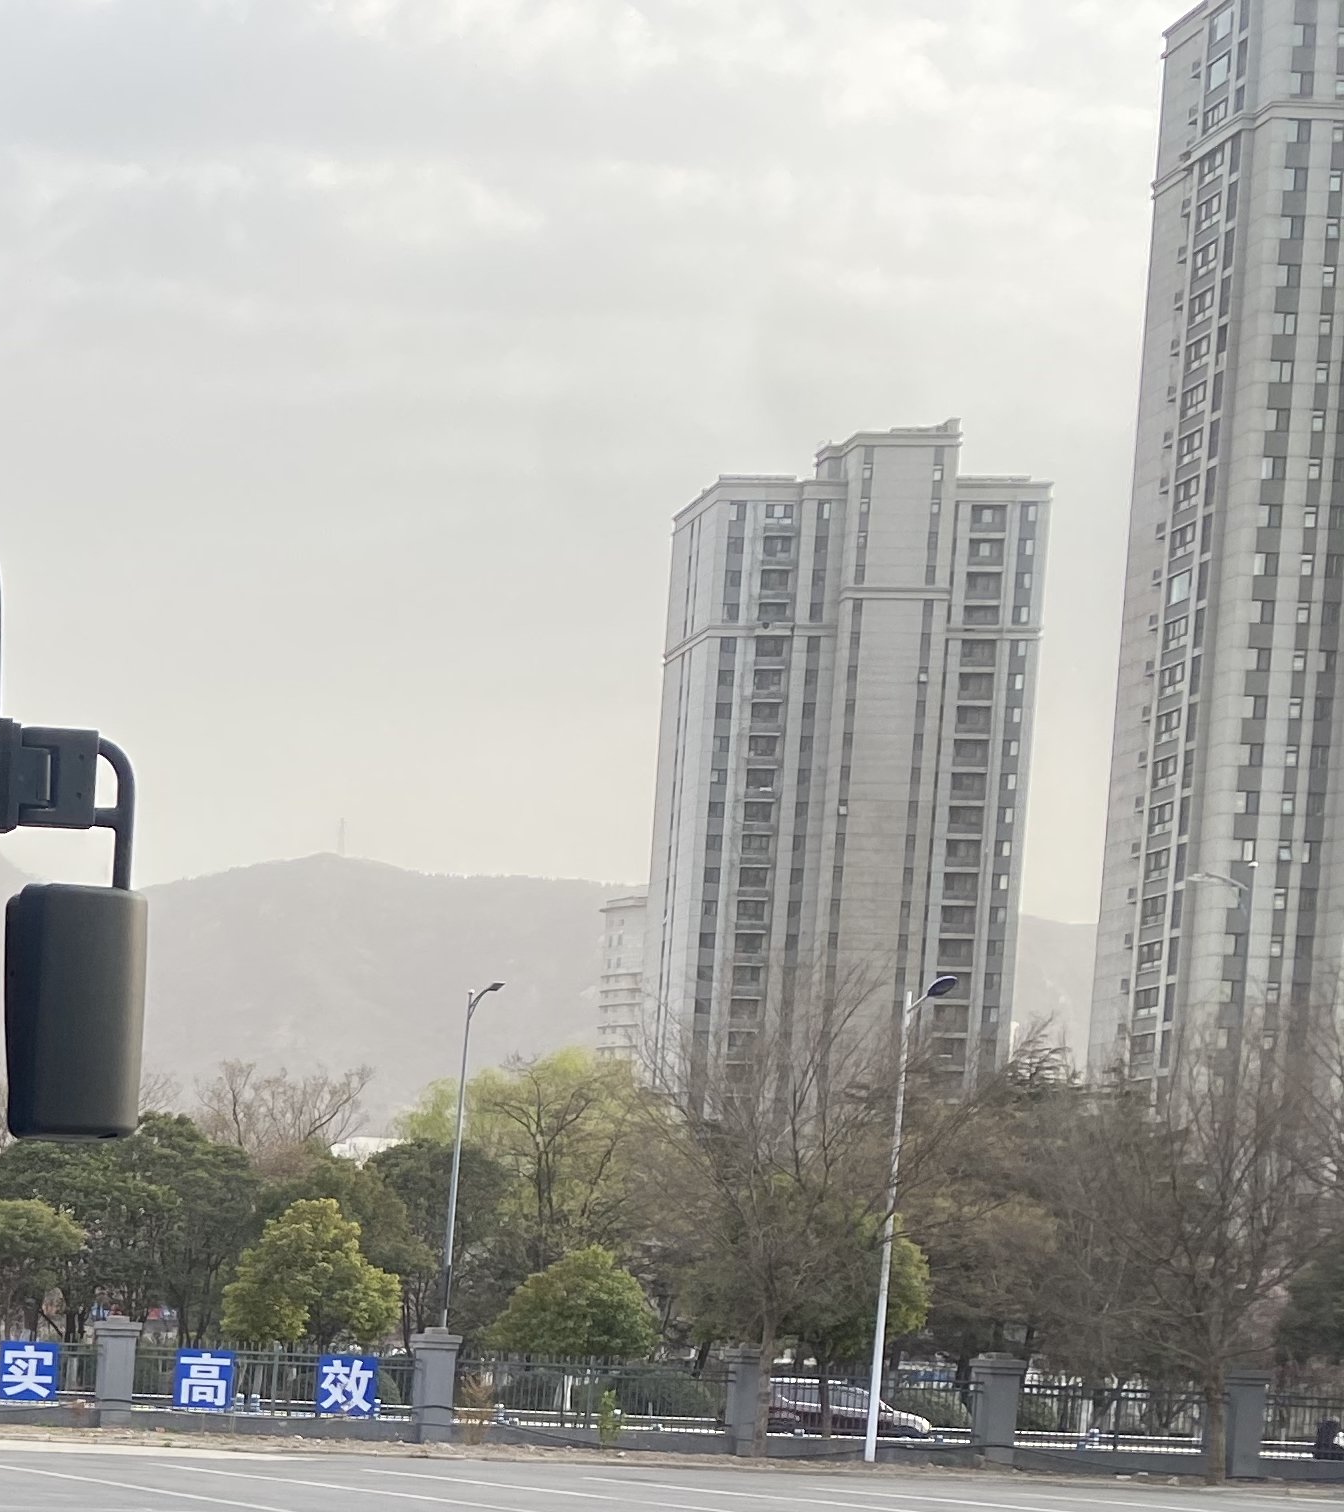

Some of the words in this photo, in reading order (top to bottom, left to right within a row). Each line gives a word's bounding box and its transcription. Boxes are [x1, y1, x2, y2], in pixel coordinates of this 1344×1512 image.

[2, 1345, 54, 1400] 实
[179, 1352, 231, 1408] 高
[321, 1358, 375, 1414] 效
